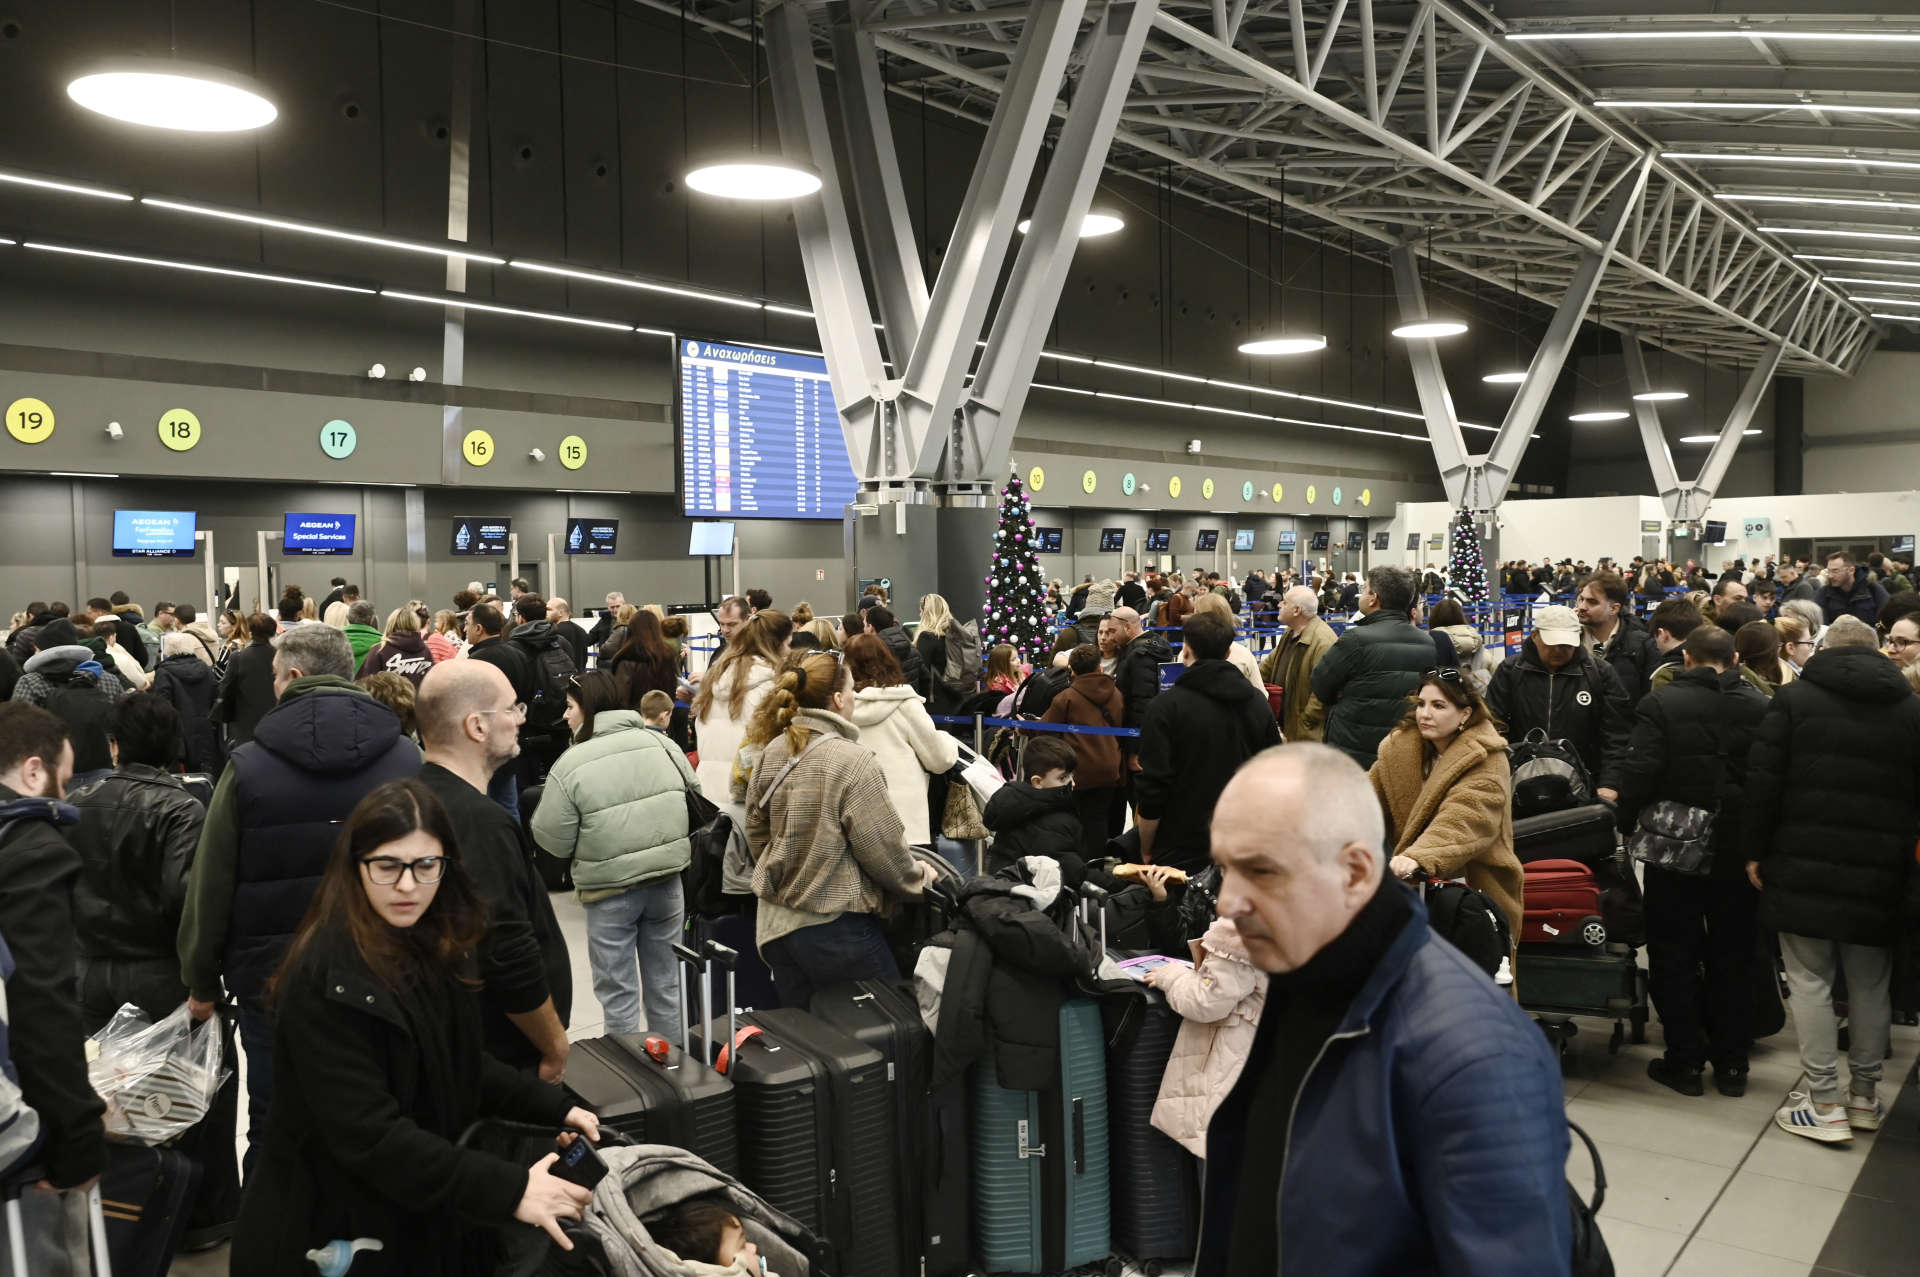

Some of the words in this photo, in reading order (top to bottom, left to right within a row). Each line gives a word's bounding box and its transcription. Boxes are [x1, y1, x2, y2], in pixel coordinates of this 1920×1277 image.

[703, 344, 777, 366] Αναχωρήσεις
[18, 411, 43, 430] 19
[169, 421, 191, 439] 18
[330, 431, 348, 447] 17
[471, 441, 487, 456] 16
[566, 446, 581, 460] 15
[1033, 474, 1041, 485] 10
[1087, 477, 1093, 487] 9
[1126, 479, 1132, 489] 8
[131, 518, 171, 526] AEGEAN
[300, 521, 334, 529] AEGEAN
[293, 532, 318, 541] Special
[319, 533, 346, 541] Services
[1506, 615, 1520, 628] LOT
